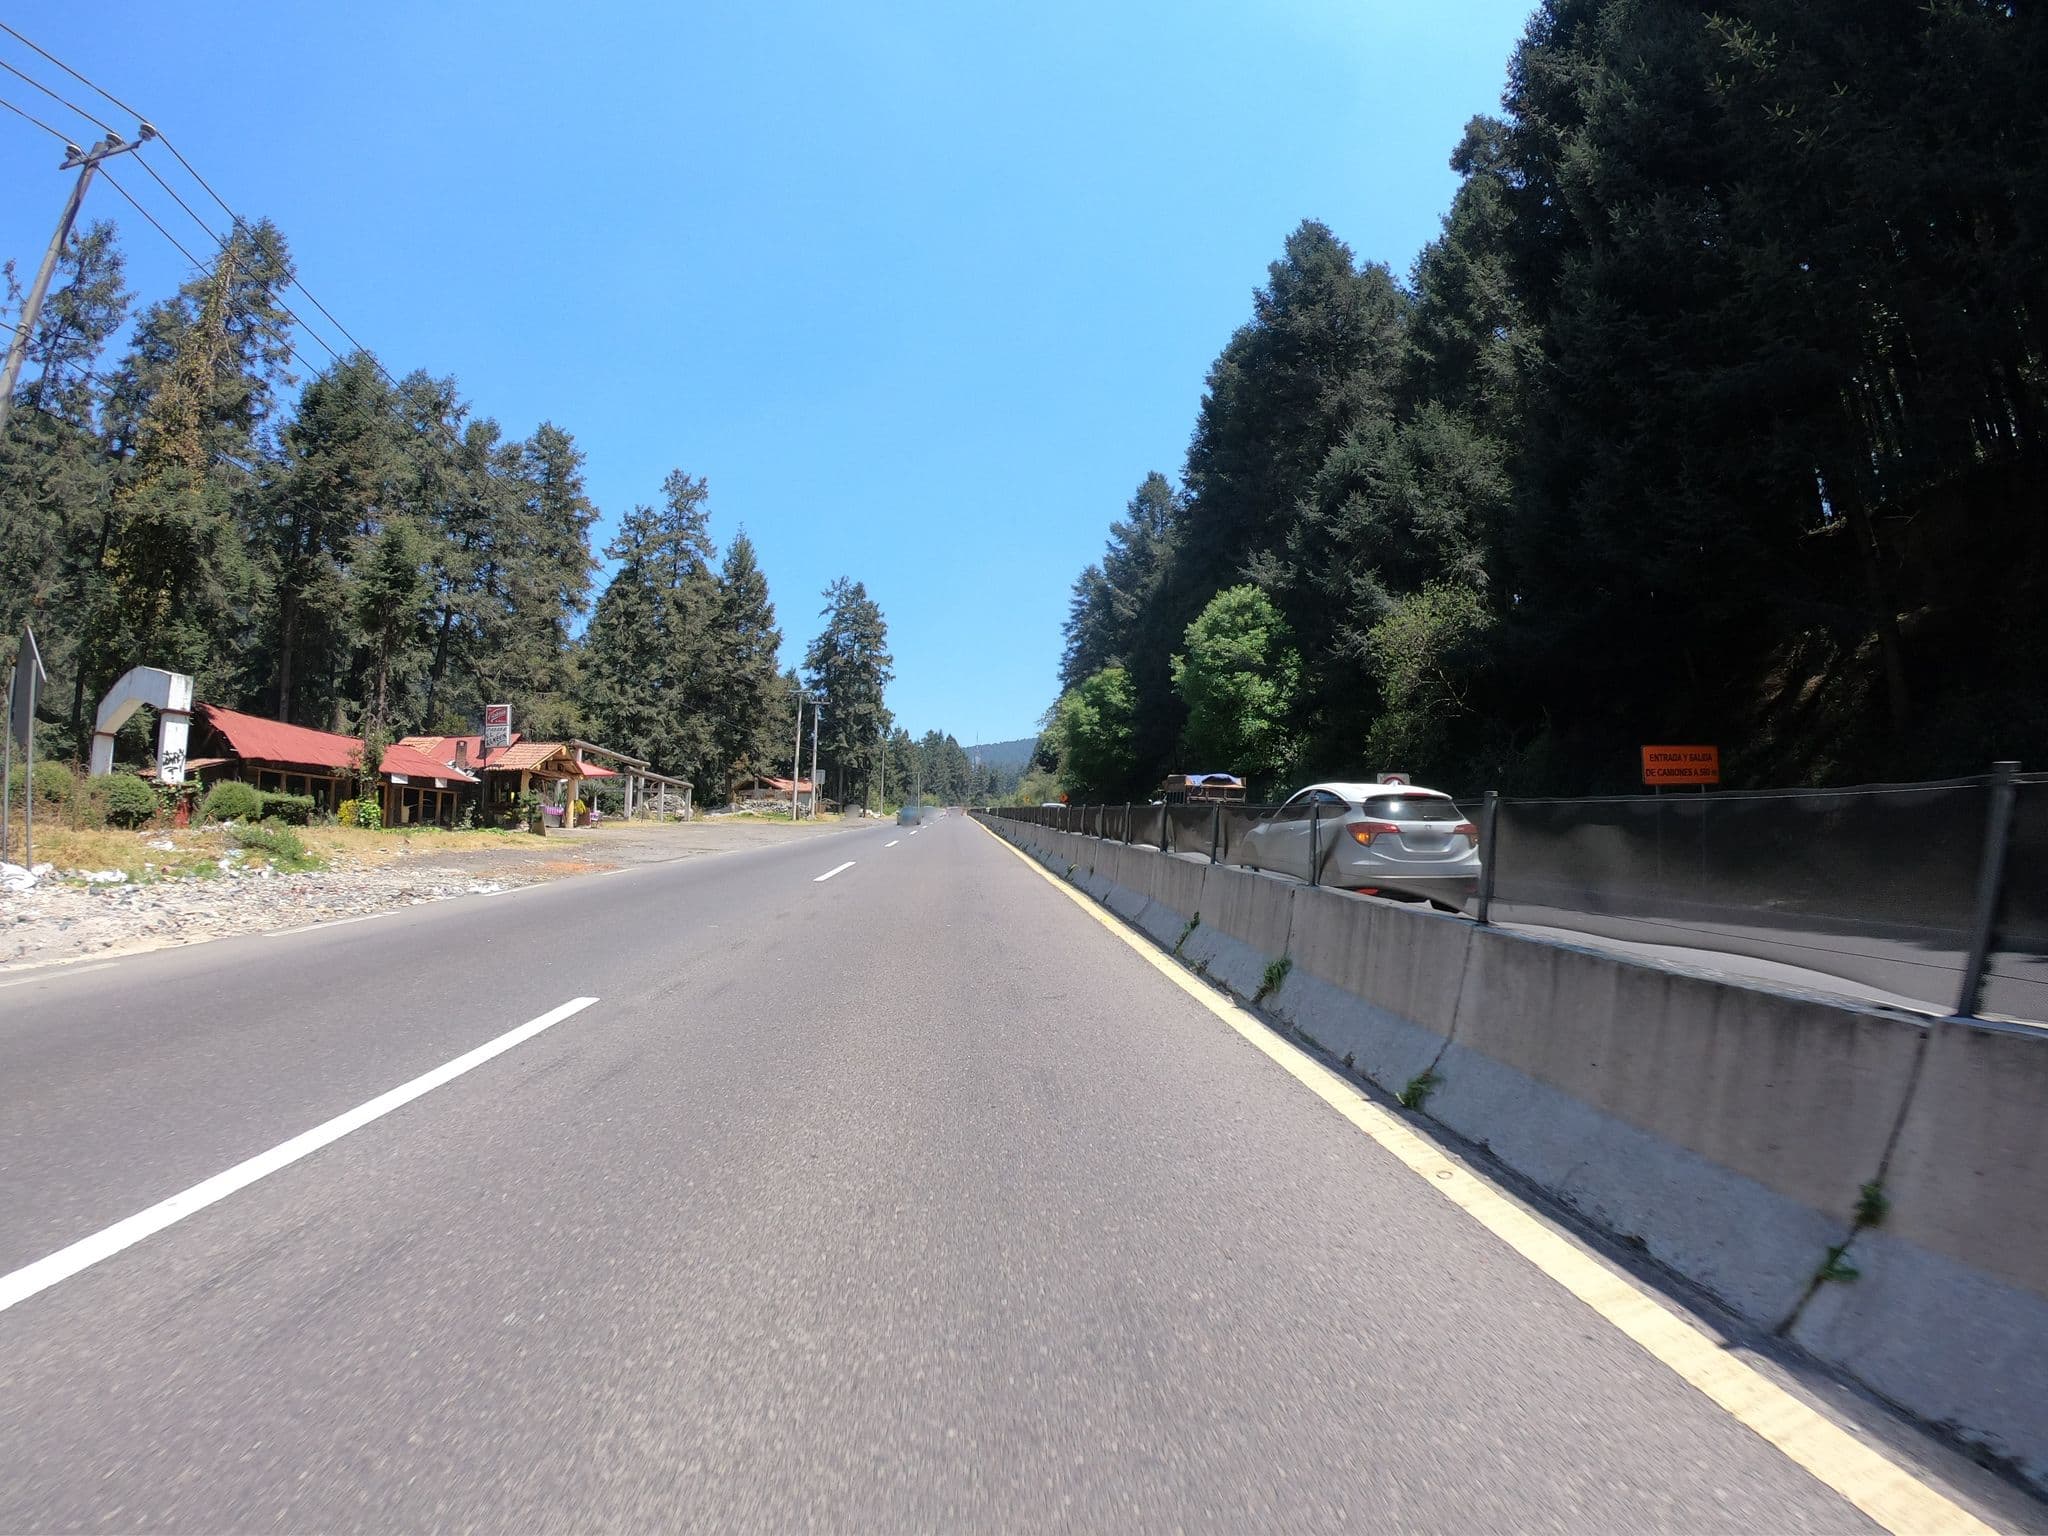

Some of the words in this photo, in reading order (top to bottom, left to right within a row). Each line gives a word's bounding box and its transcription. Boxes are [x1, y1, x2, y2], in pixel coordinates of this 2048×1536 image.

[1649, 753, 1681, 762] ENTRADA
[1689, 753, 1713, 762] SALIDA
[1645, 768, 1656, 776] DE
[1657, 768, 1693, 776] CAMIONES
